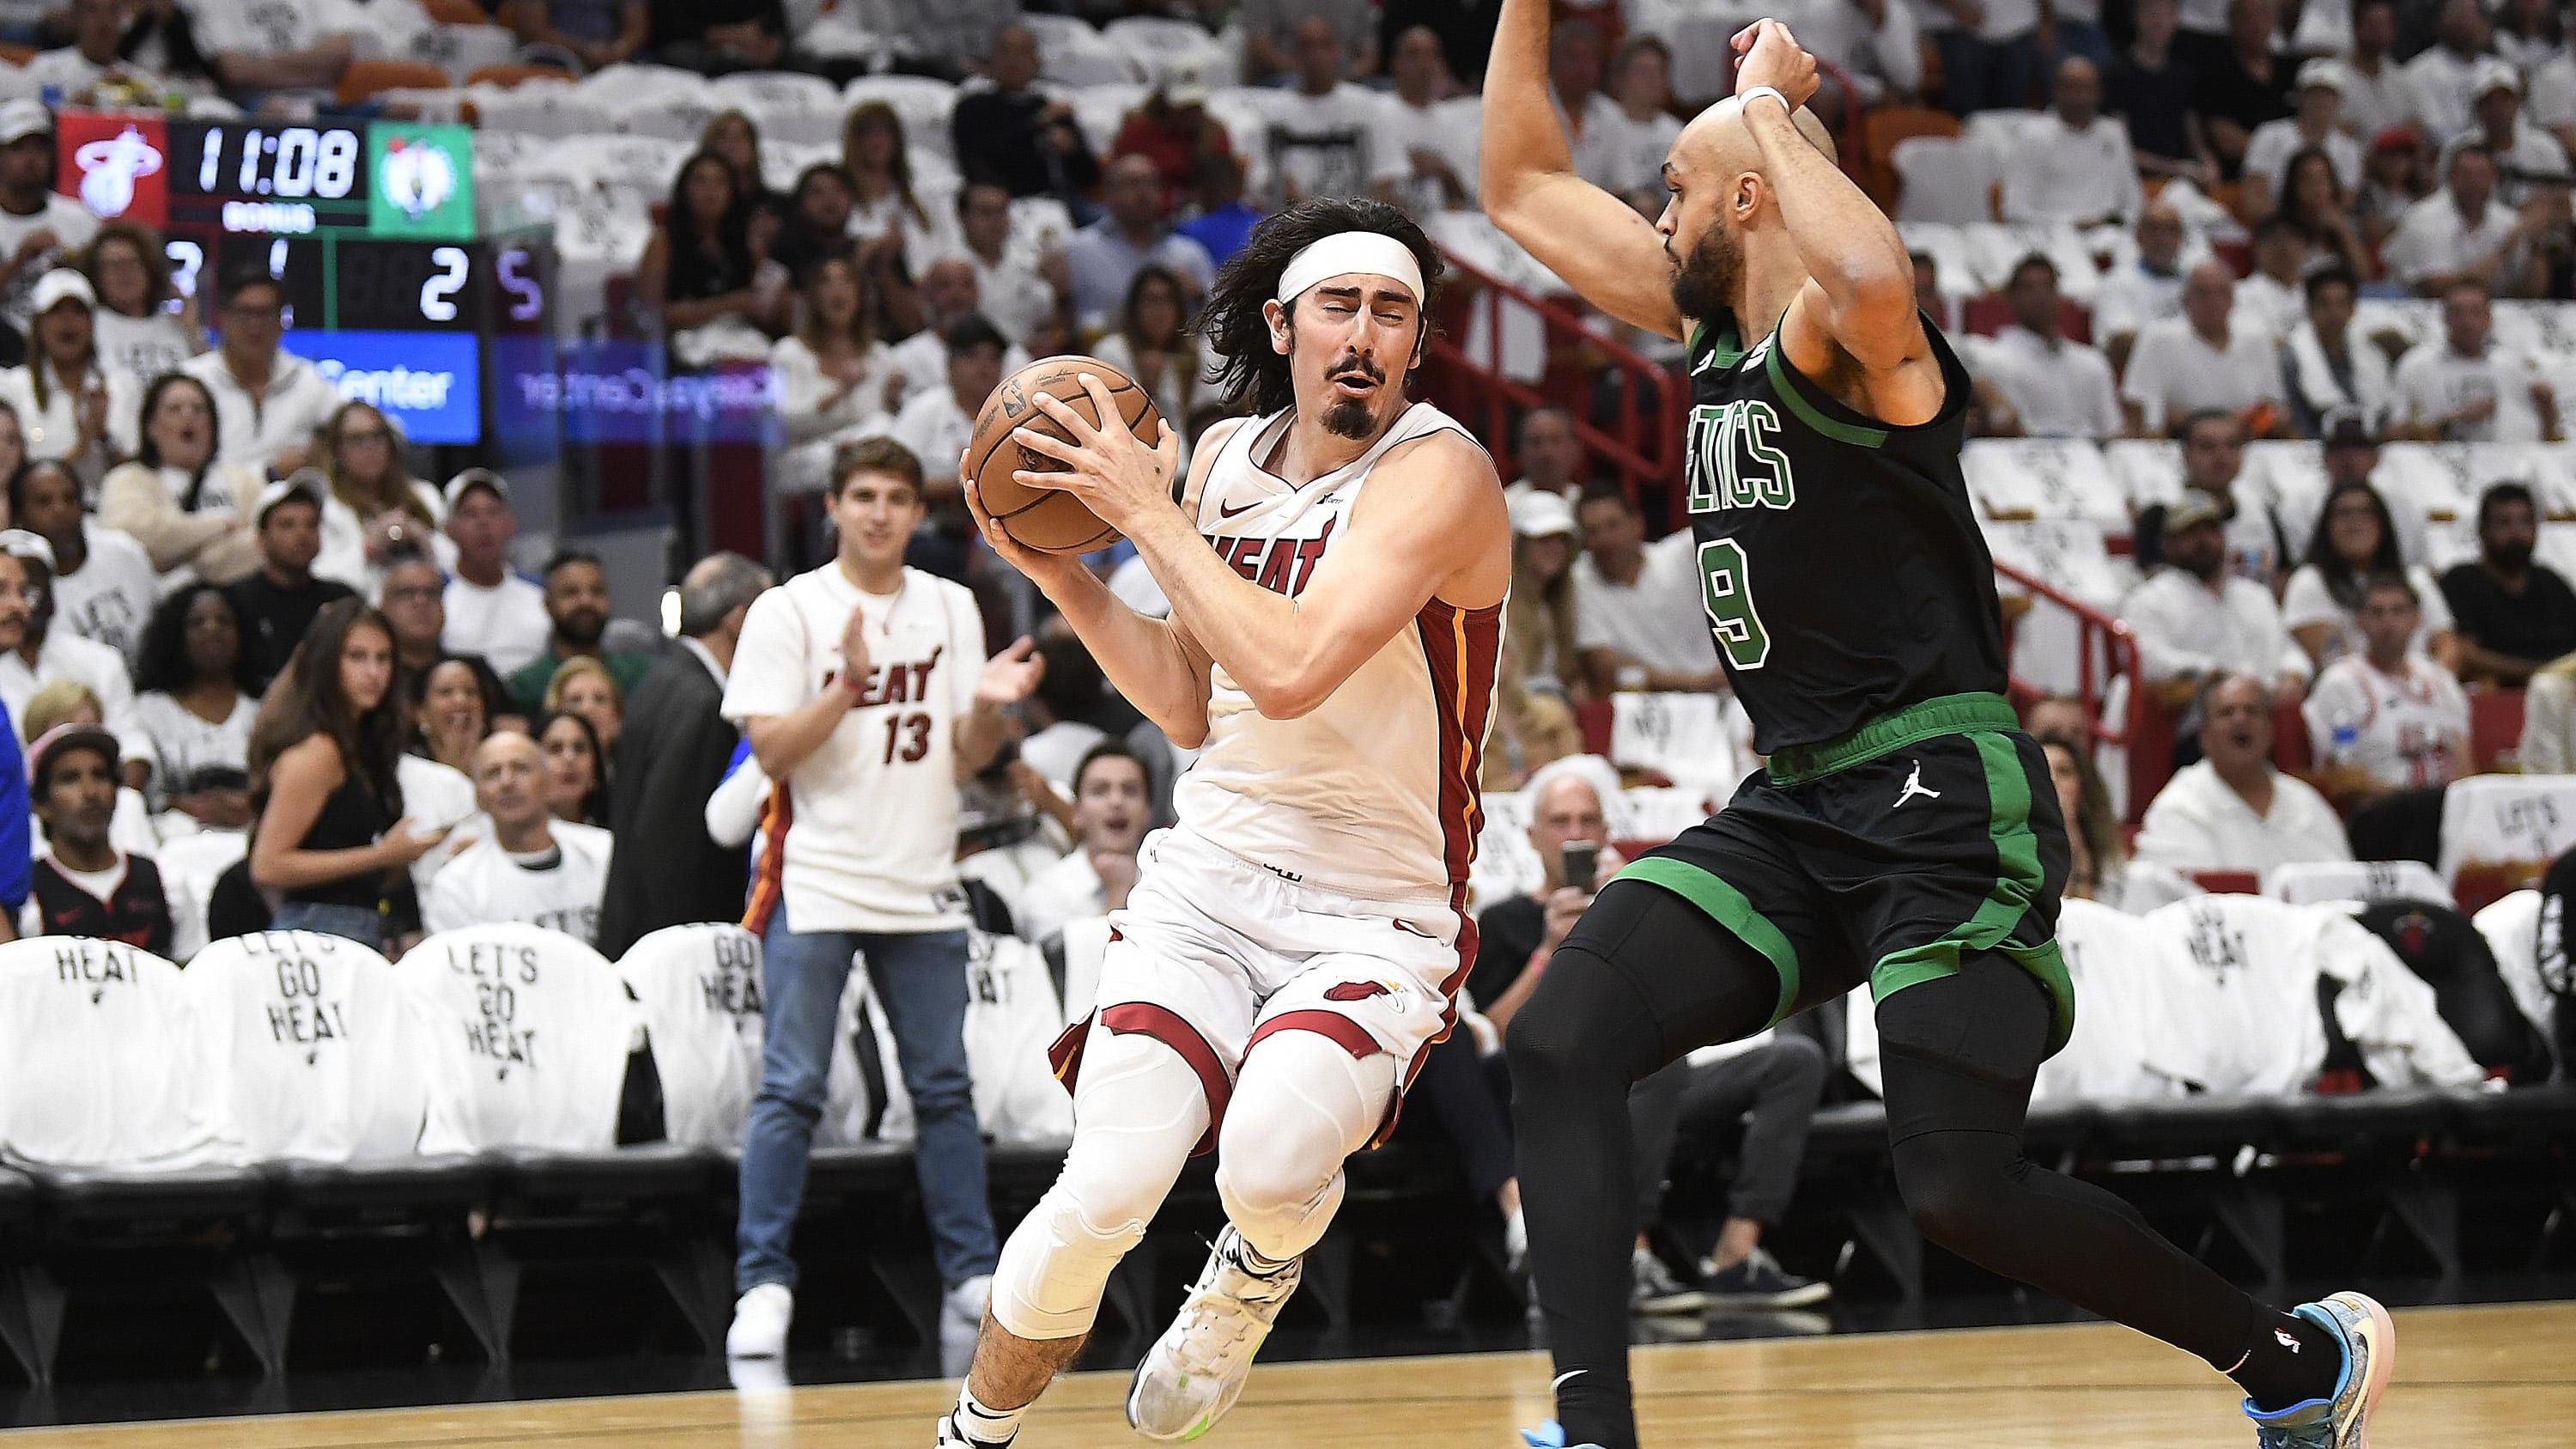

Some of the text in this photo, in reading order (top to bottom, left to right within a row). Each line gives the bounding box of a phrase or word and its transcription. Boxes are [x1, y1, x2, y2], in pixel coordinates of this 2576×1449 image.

[198, 126, 359, 199] 11:08
[419, 247, 471, 322] 2
[318, 358, 455, 411] enter
[1697, 537, 1771, 671] 9
[884, 711, 931, 764] 13
[276, 958, 322, 999] GO
[446, 943, 538, 983] LET'S
[697, 973, 766, 1014] HEA
[265, 999, 349, 1043] HEAT
[463, 1019, 537, 1068] HEAT
